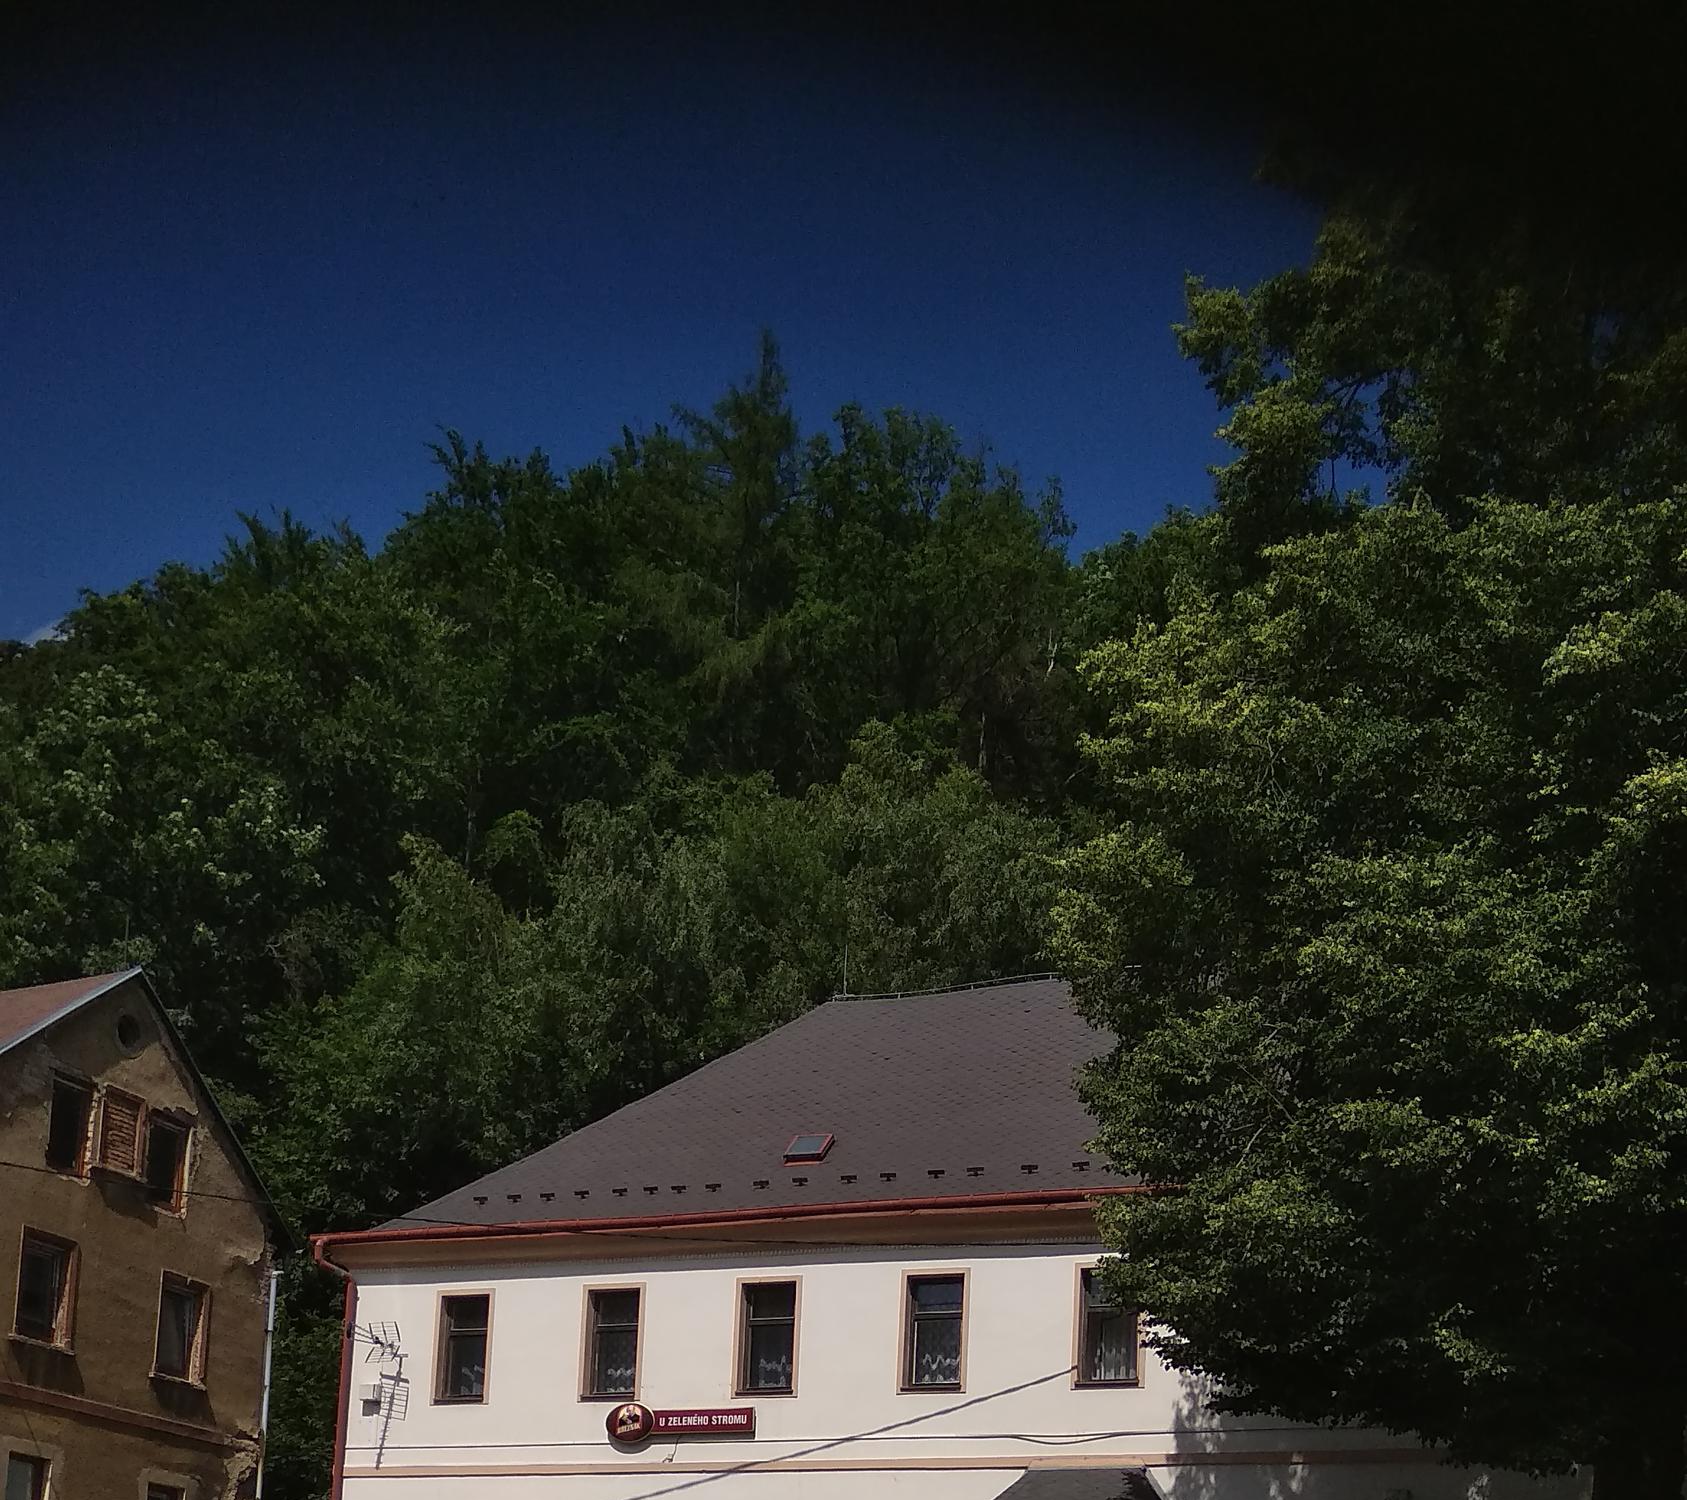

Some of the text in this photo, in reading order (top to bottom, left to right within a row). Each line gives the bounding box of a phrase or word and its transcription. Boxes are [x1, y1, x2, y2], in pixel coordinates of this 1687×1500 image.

[659, 1414, 747, 1427] U ZELENÉHO STROMU
